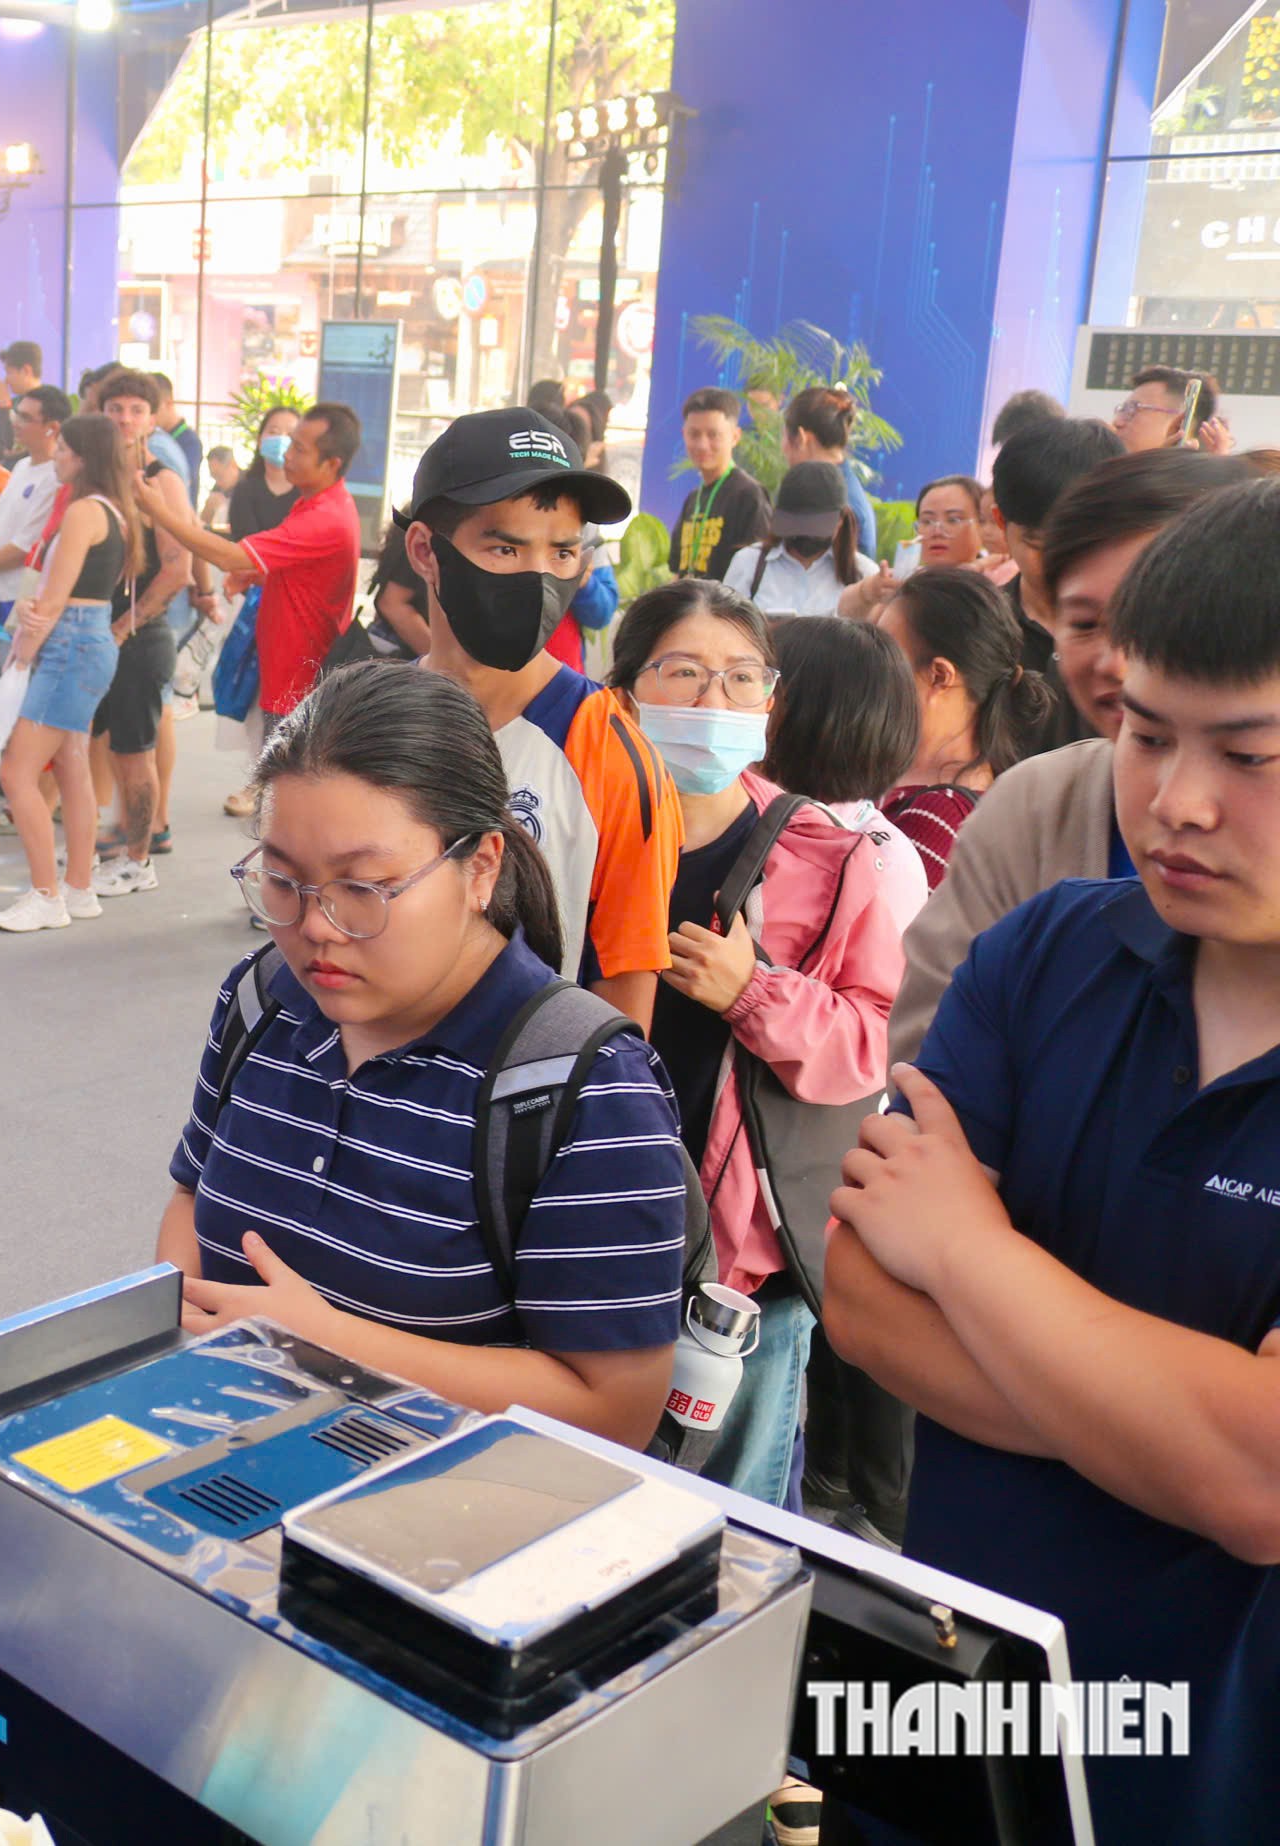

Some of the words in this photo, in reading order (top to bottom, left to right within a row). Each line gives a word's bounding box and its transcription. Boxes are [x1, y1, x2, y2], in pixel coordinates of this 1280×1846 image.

[1200, 216, 1280, 249] CH
[508, 430, 567, 459] ESR
[531, 451, 551, 460] MADE
